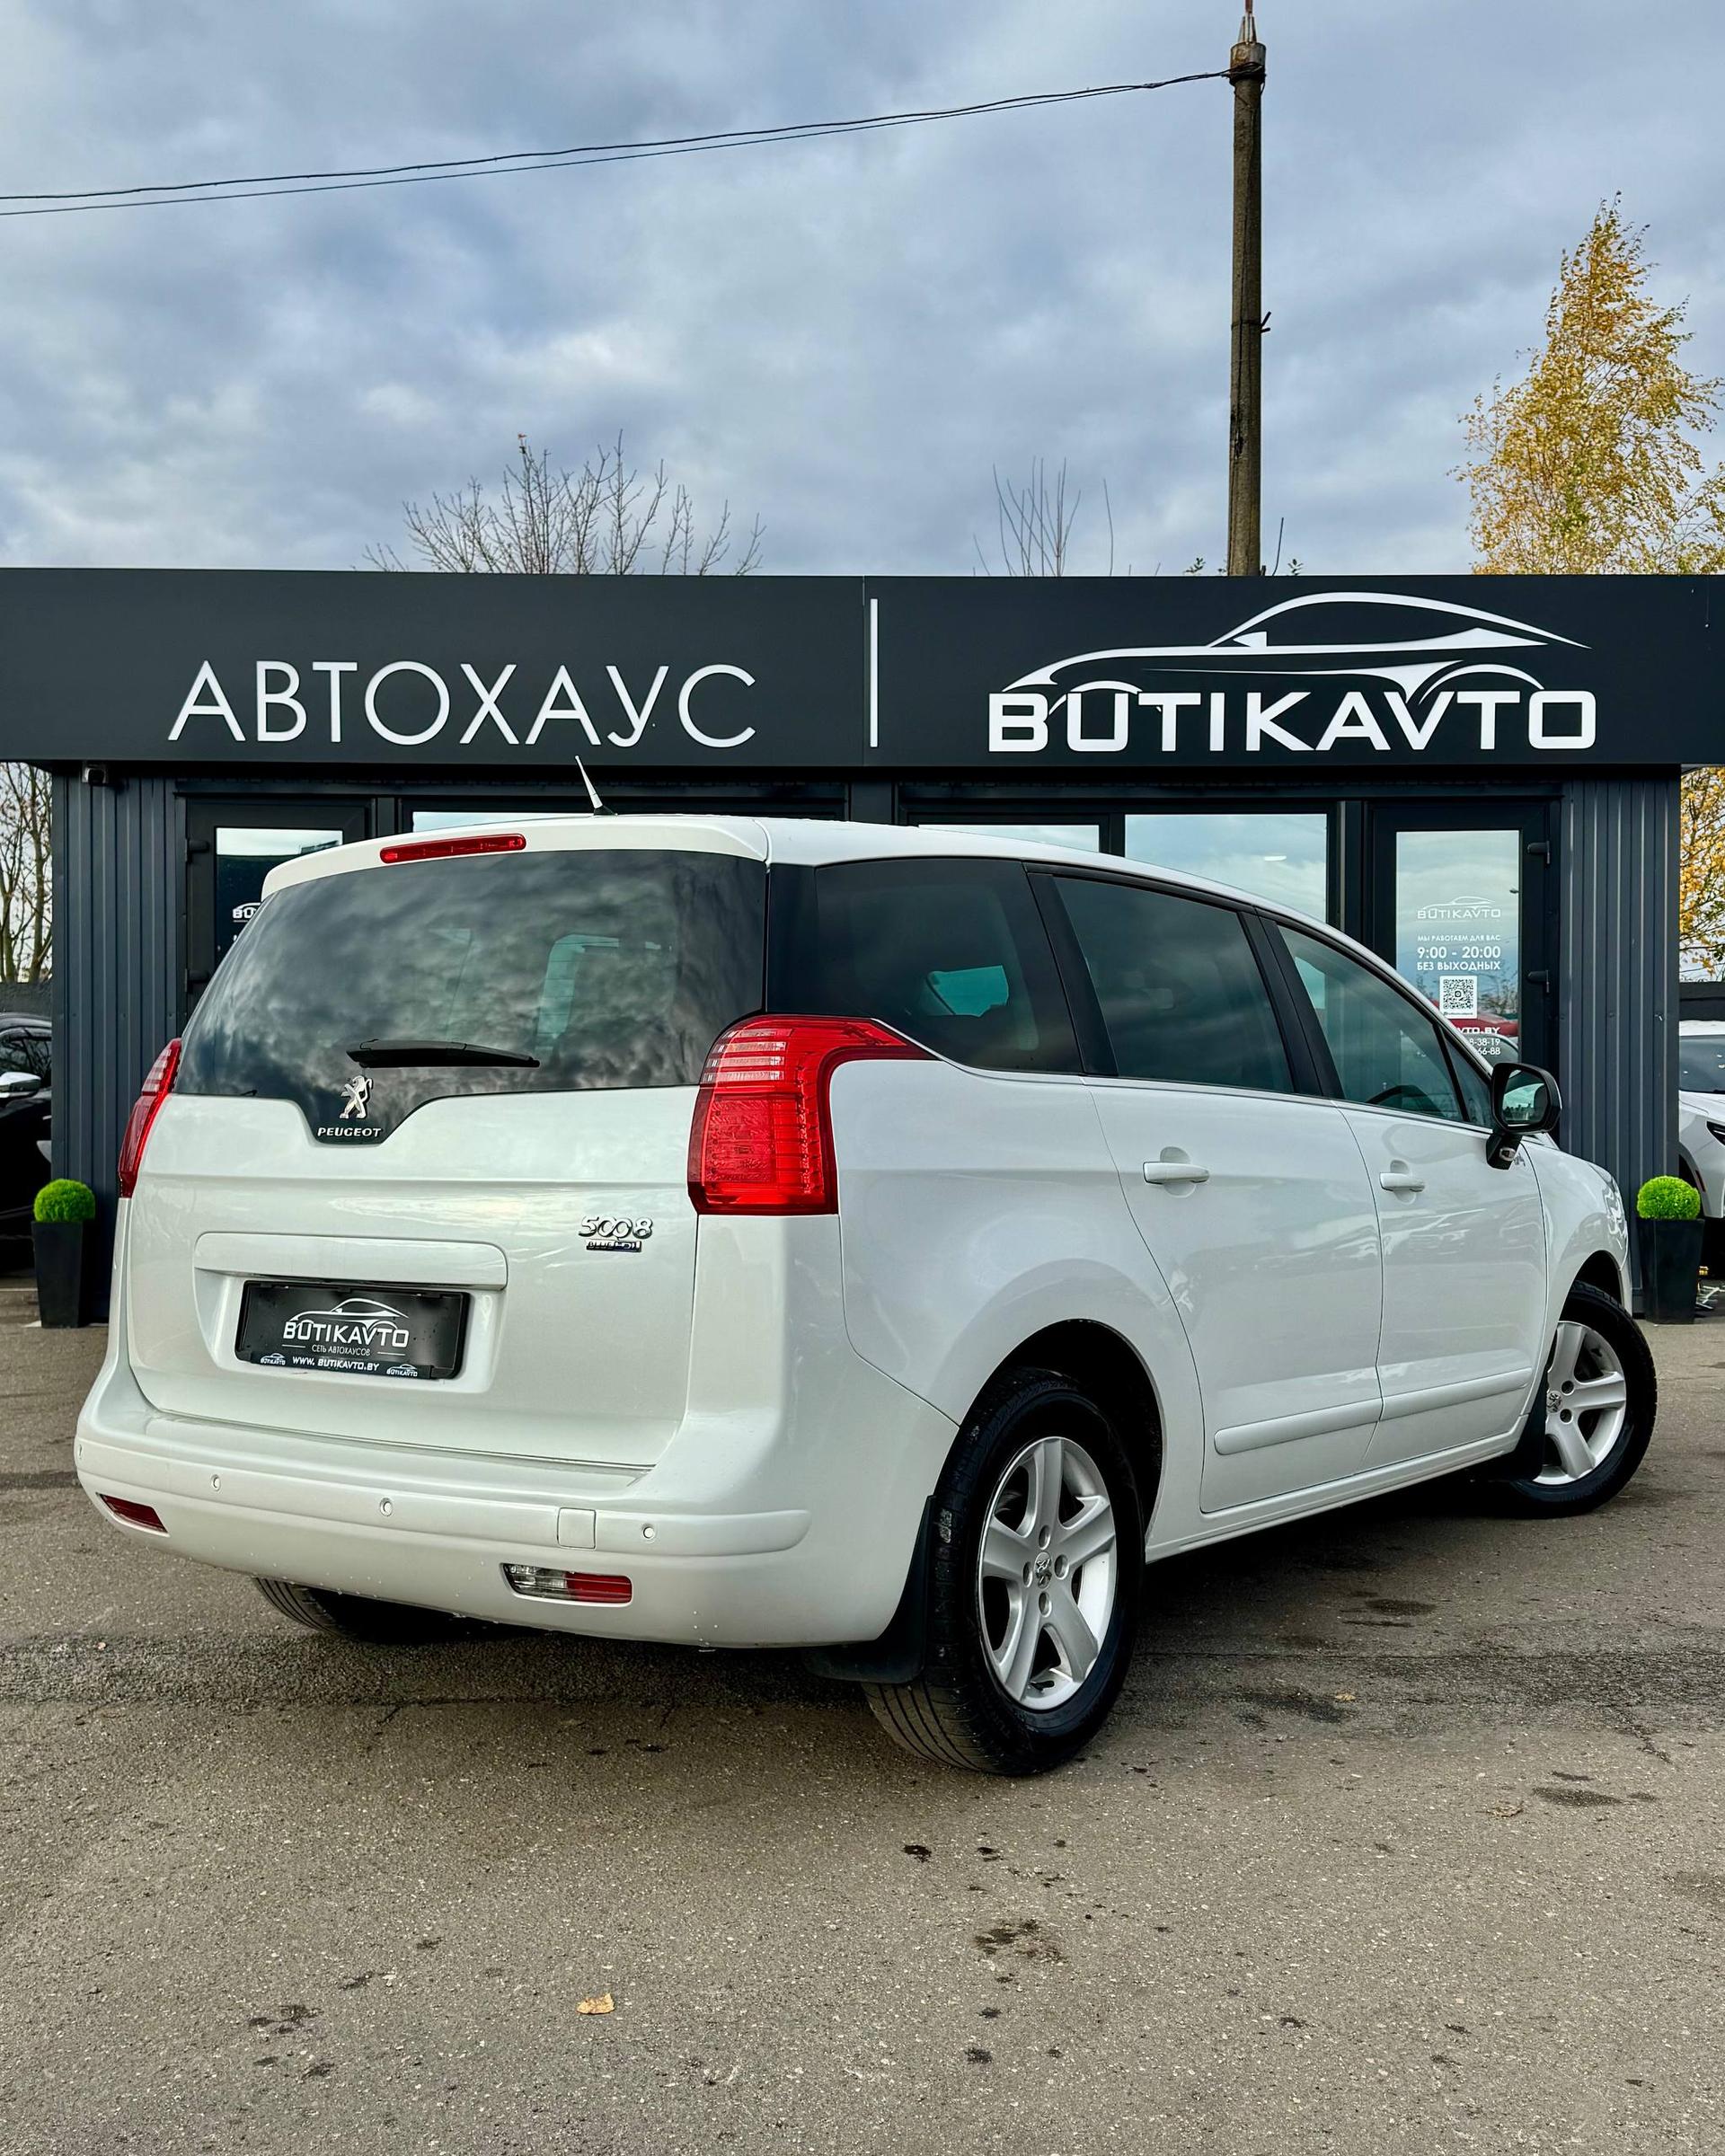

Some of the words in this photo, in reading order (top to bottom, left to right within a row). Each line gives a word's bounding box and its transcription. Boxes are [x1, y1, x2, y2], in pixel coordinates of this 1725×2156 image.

[168, 660, 756, 747] АВТОХАУС
[988, 690, 1596, 752] BUTIKAVTO
[1418, 909, 1500, 919] BUTIKAVTO
[1418, 947, 1446, 959] 9:00
[1462, 946, 1500, 959] 20:00
[1417, 962, 1434, 970] БЕЗ
[1438, 961, 1500, 971] ВЫХОДНЫХ
[317, 1127, 381, 1137] PEUGEOT
[578, 1215, 653, 1239] 5008
[283, 1320, 410, 1348] BUTIKAVTO
[312, 1344, 327, 1354] СЕТЬ
[327, 1346, 371, 1356] АВТОХАУСОВ
[386, 1368, 418, 1377] BUTIKAVTO
